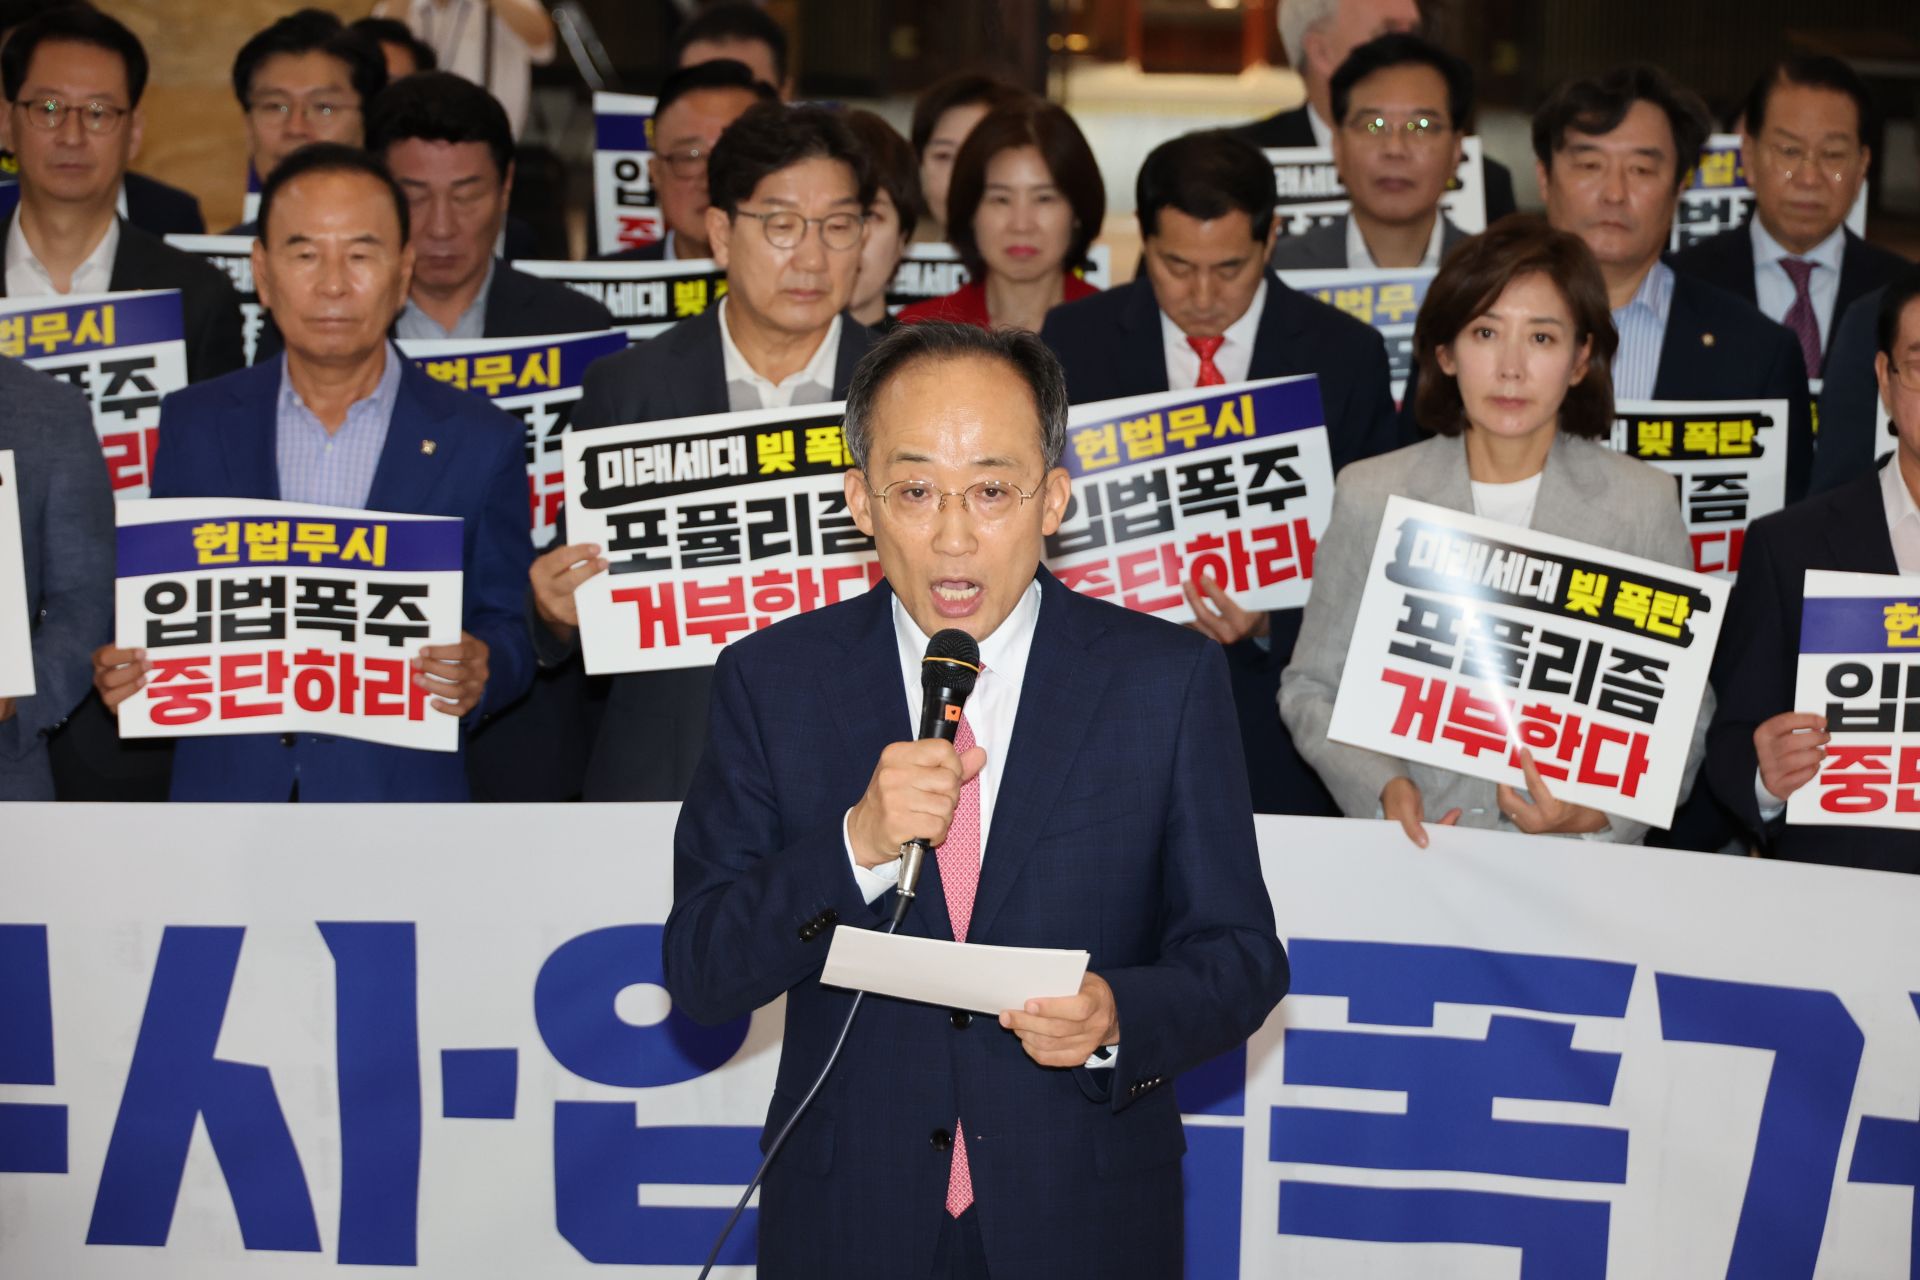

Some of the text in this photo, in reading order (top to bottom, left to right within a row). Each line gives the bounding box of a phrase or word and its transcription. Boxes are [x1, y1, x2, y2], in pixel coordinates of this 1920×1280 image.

[597, 426, 856, 490] 미래세대 빚 폭
[1071, 395, 1257, 472] 헌법무시
[1637, 420, 1673, 457] 빚
[1682, 419, 1756, 456] 폭탄
[192, 521, 388, 568] 헌법무시
[143, 575, 431, 649] 입법폭주
[1408, 528, 1690, 639] 미래세대 빚 폭탄
[146, 648, 431, 726] 중단하라
[1380, 668, 1651, 799] 거부한다
